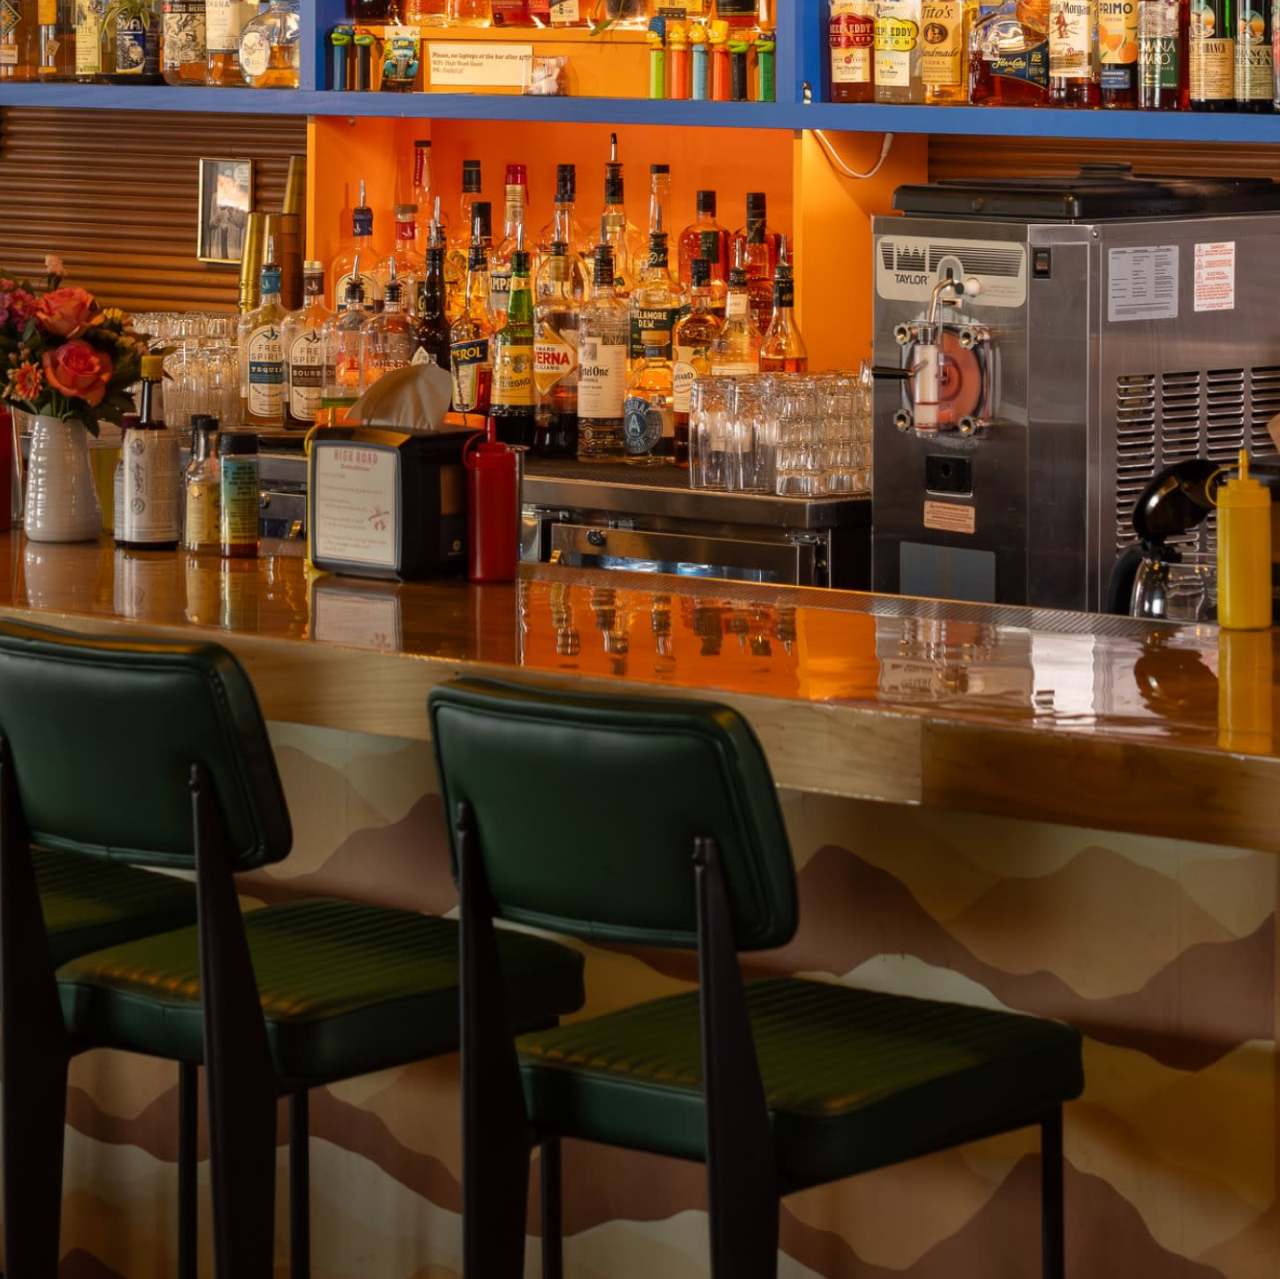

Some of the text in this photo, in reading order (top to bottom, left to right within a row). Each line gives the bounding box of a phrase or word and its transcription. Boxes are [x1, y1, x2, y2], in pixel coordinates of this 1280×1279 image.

[922, 4, 954, 20] Tito's
[891, 26, 914, 37] EDDY
[895, 274, 929, 286] TAYLOR
[593, 367, 609, 377] One
